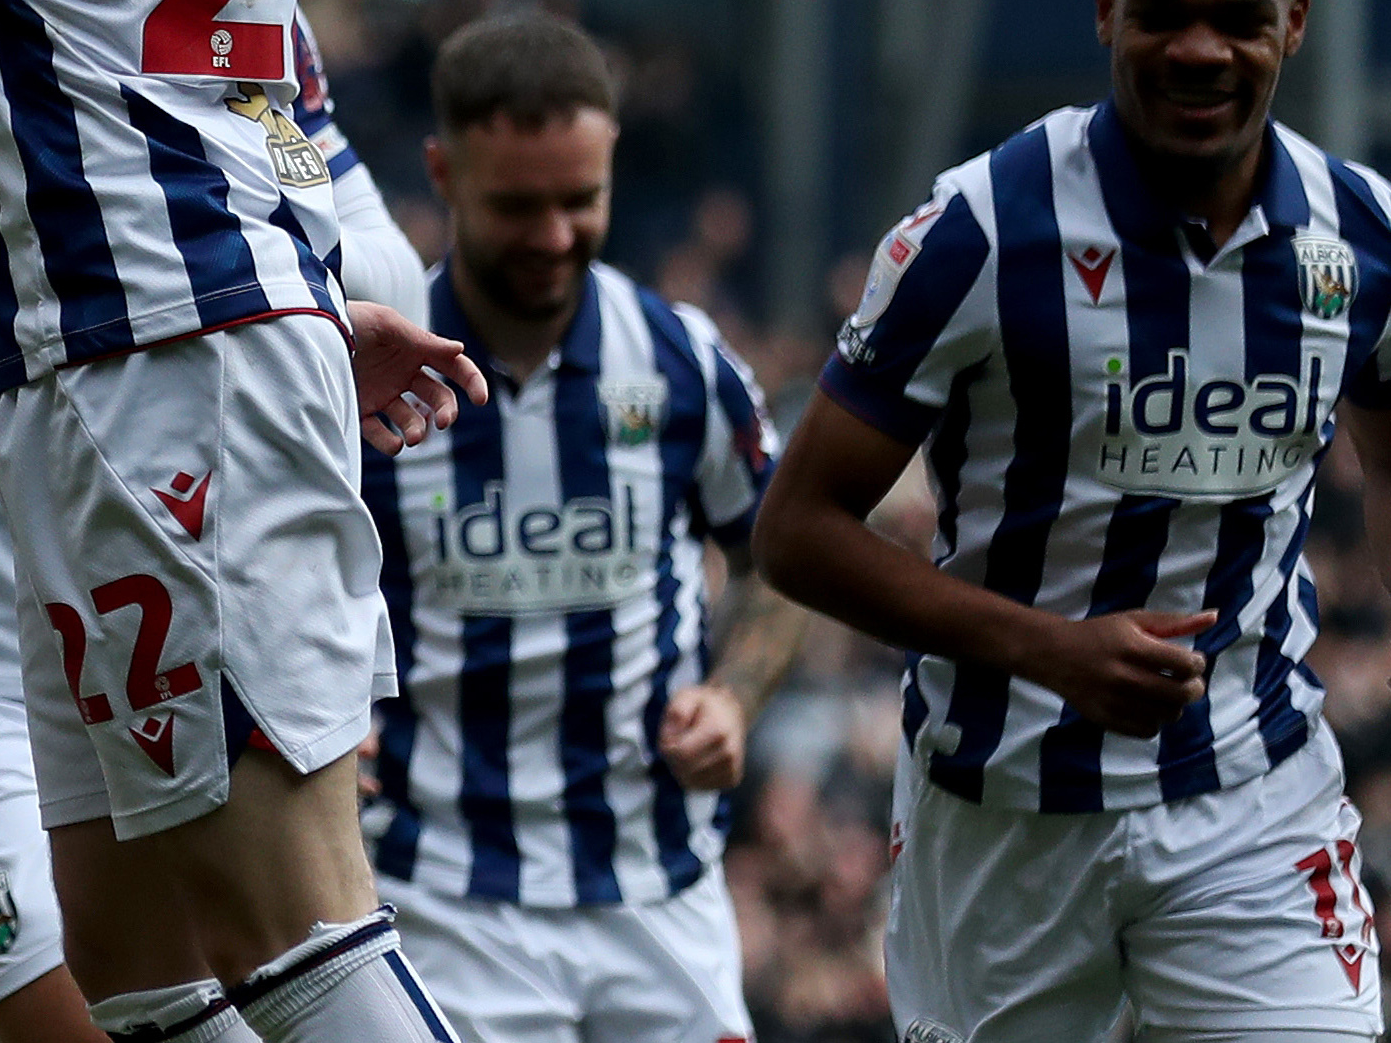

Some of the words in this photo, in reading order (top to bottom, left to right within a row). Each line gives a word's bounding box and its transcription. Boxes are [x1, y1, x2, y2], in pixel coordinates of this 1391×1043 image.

[212, 57, 231, 67] EFL
[1301, 249, 1352, 264] ALBION
[1105, 355, 1321, 436] ideal
[1100, 444, 1306, 476] HEATING
[434, 490, 634, 562] ideal
[435, 564, 639, 597] HEATING
[45, 574, 203, 725] 22
